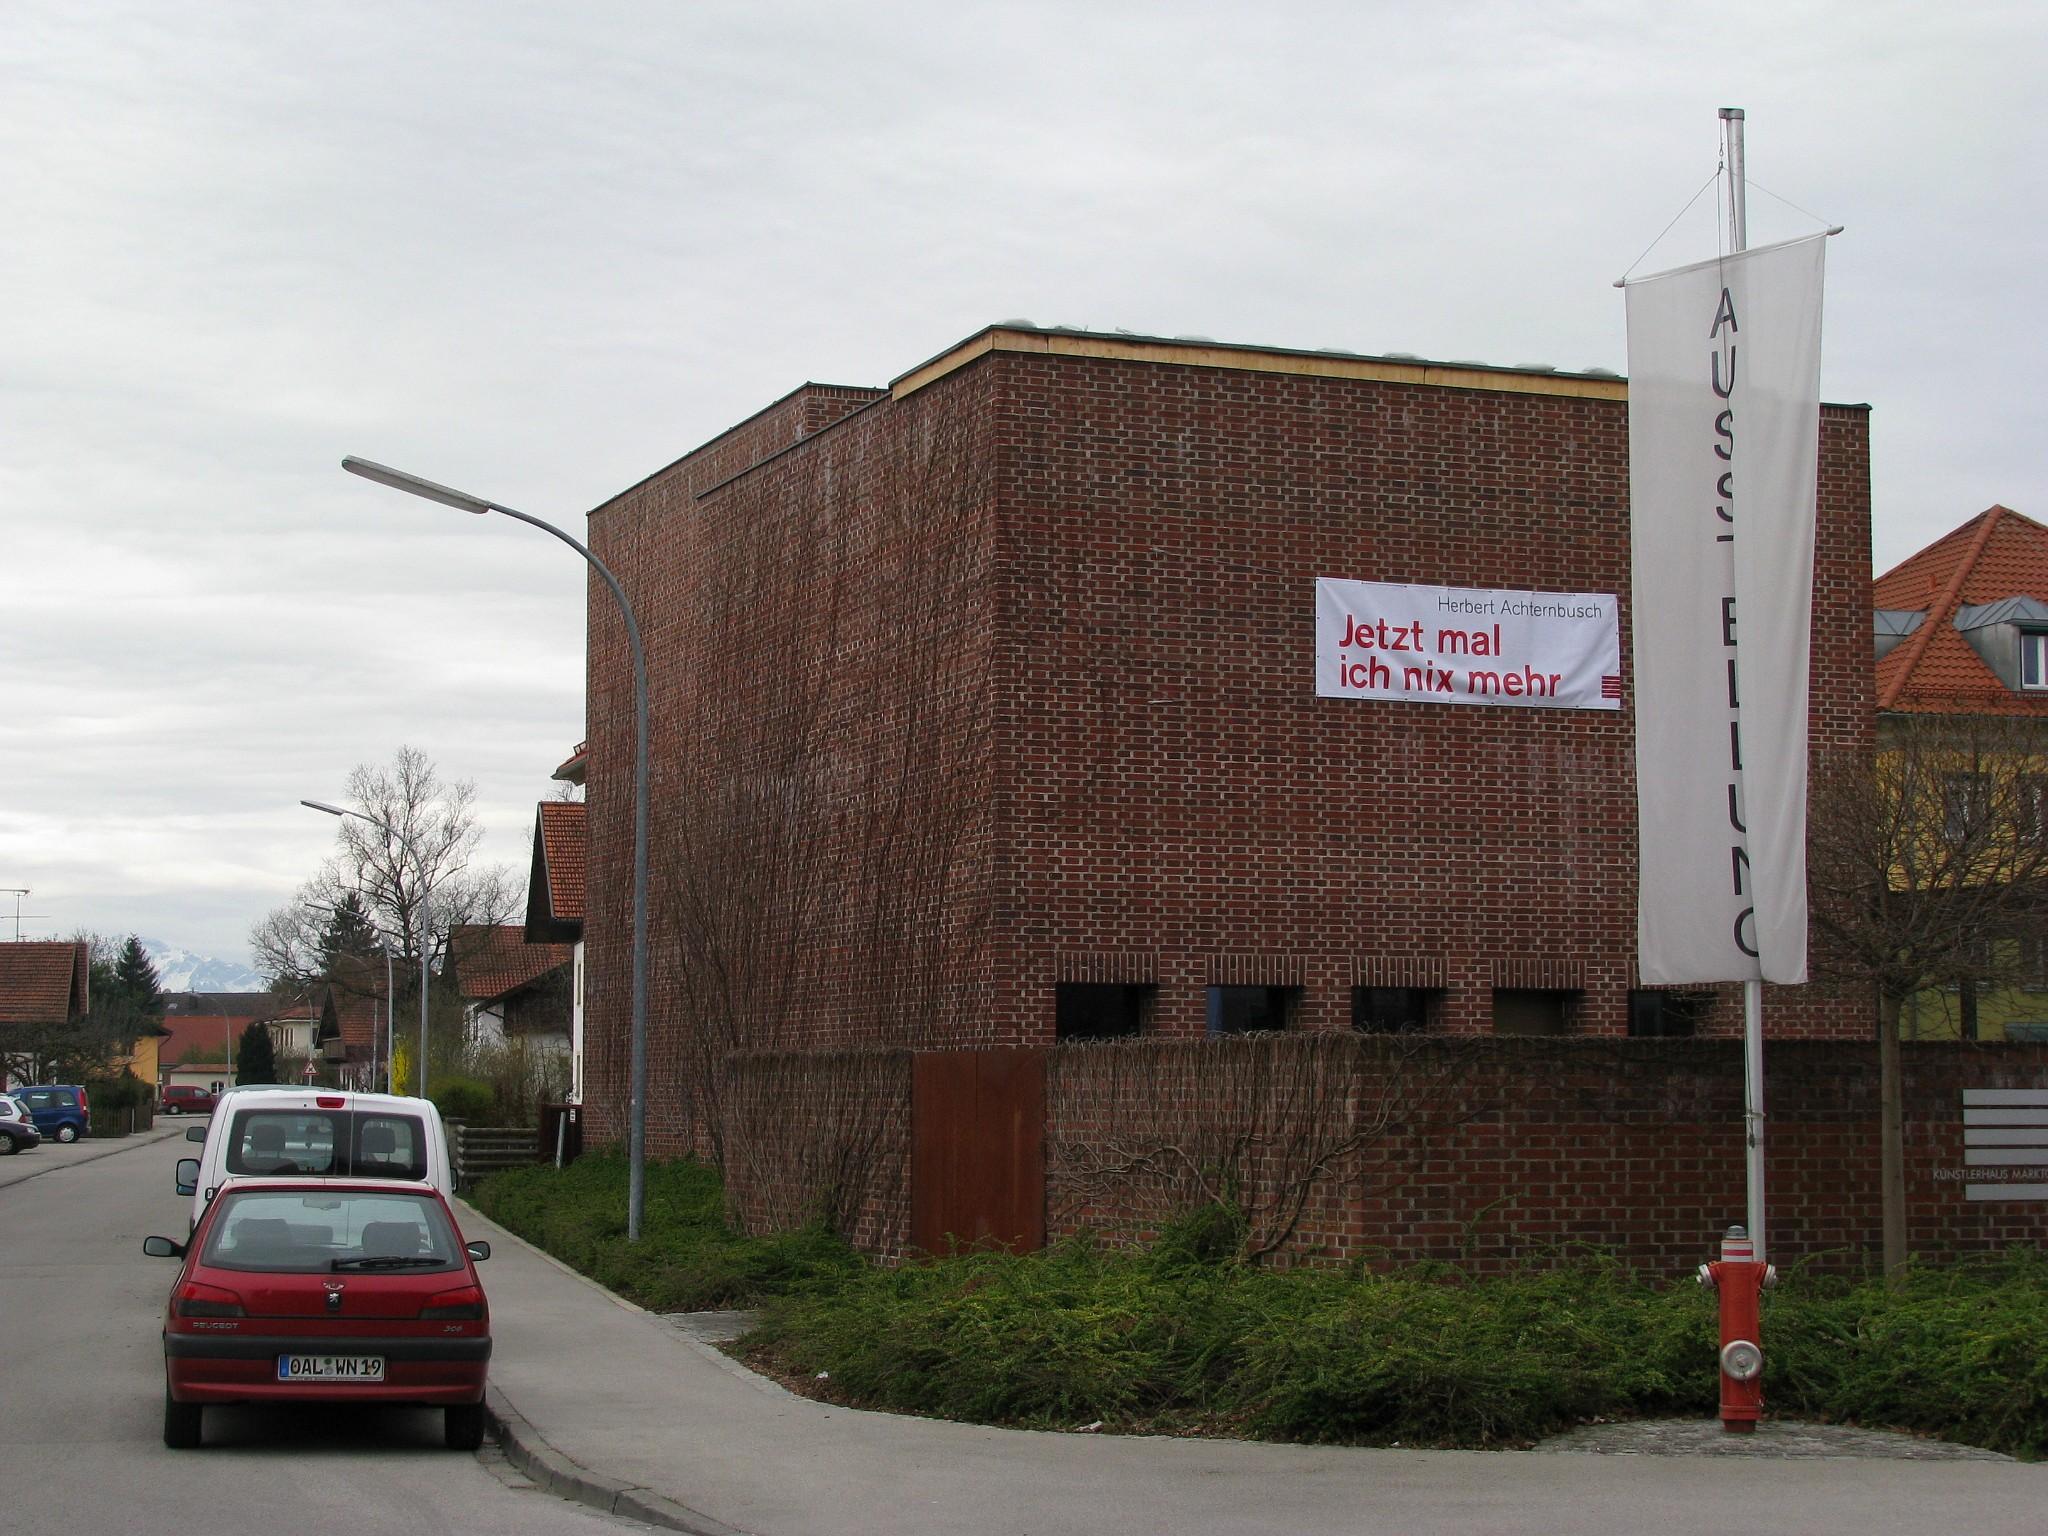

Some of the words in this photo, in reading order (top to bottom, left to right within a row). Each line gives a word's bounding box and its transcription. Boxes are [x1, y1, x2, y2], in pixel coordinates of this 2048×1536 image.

[1438, 596, 1495, 615] Herbert
[1500, 600, 1602, 619] Achternbusch
[1339, 614, 1424, 652] Jetzt
[1438, 623, 1500, 656] mal
[1340, 654, 1390, 690] ich
[1404, 660, 1454, 693] nix
[1467, 664, 1562, 697] mehr
[192, 1321, 240, 1329] PEUGEOT
